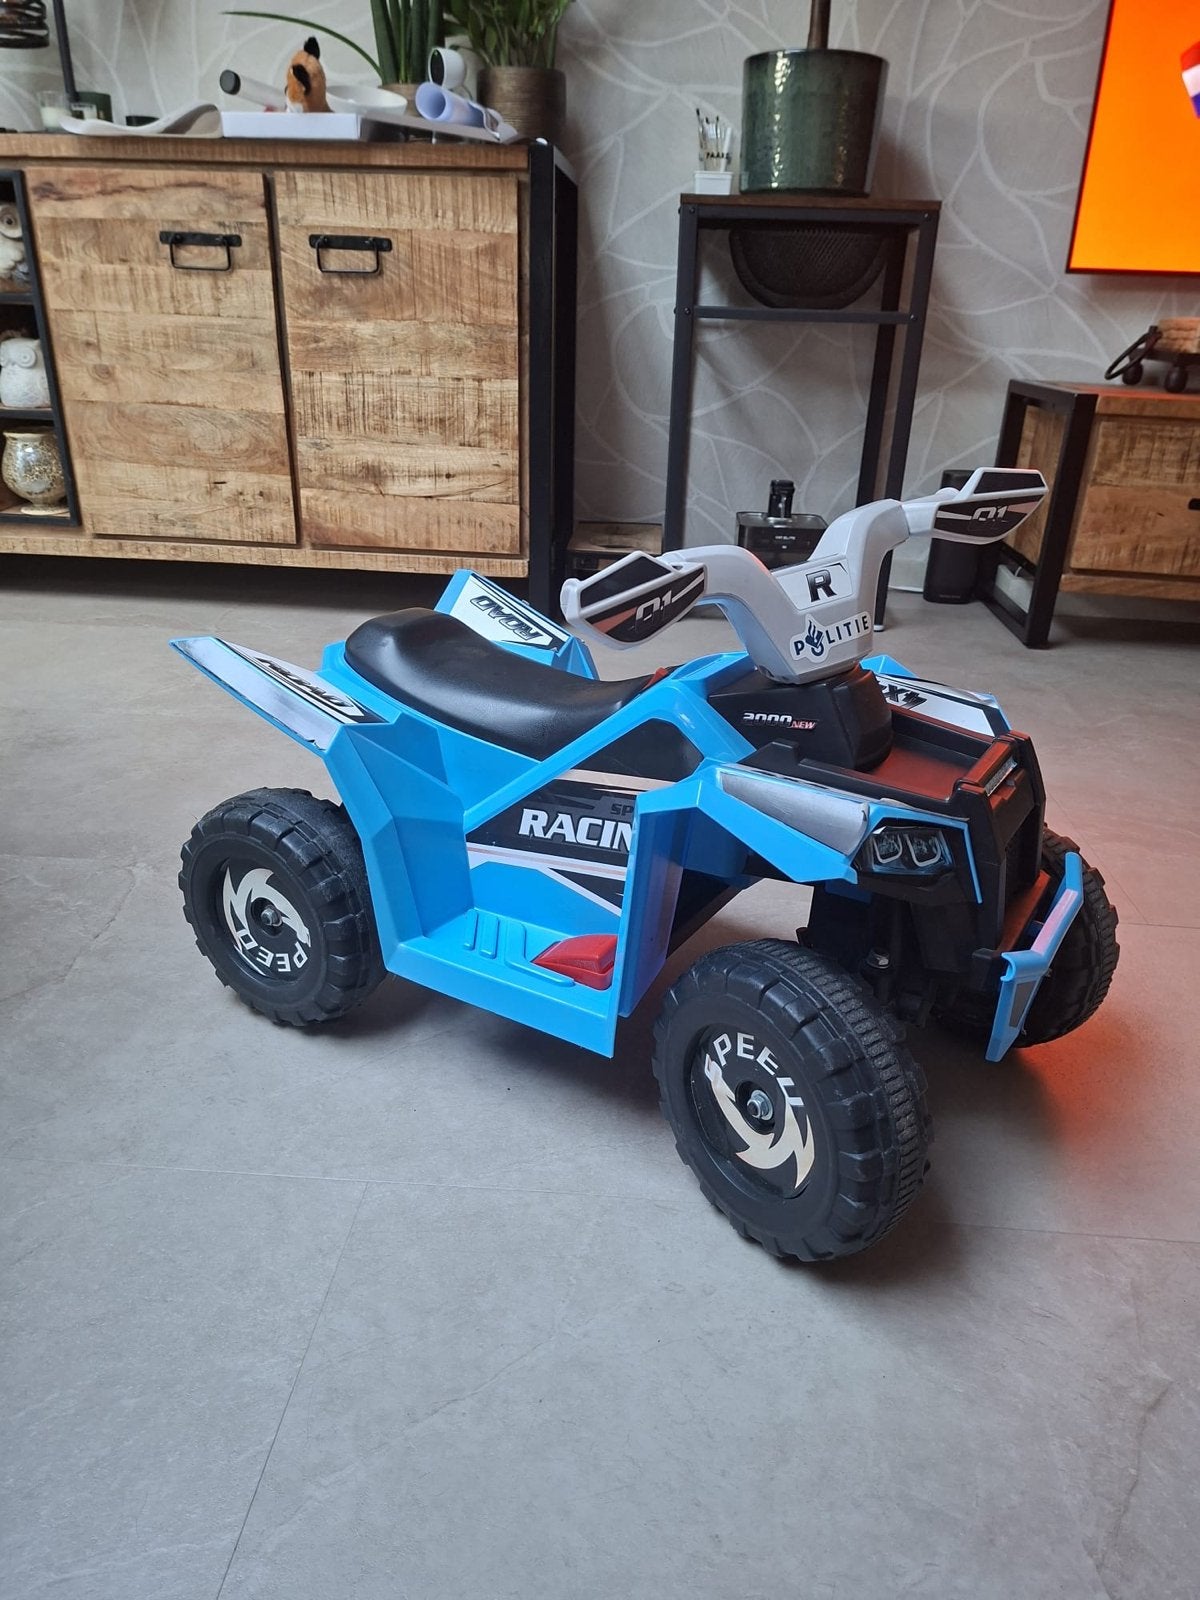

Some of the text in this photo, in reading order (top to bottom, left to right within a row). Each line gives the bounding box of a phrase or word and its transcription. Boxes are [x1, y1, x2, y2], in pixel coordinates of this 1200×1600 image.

[805, 569, 838, 603] R
[469, 595, 544, 641] ROAD
[793, 615, 870, 657] POLITIE
[790, 720, 817, 730] NEW
